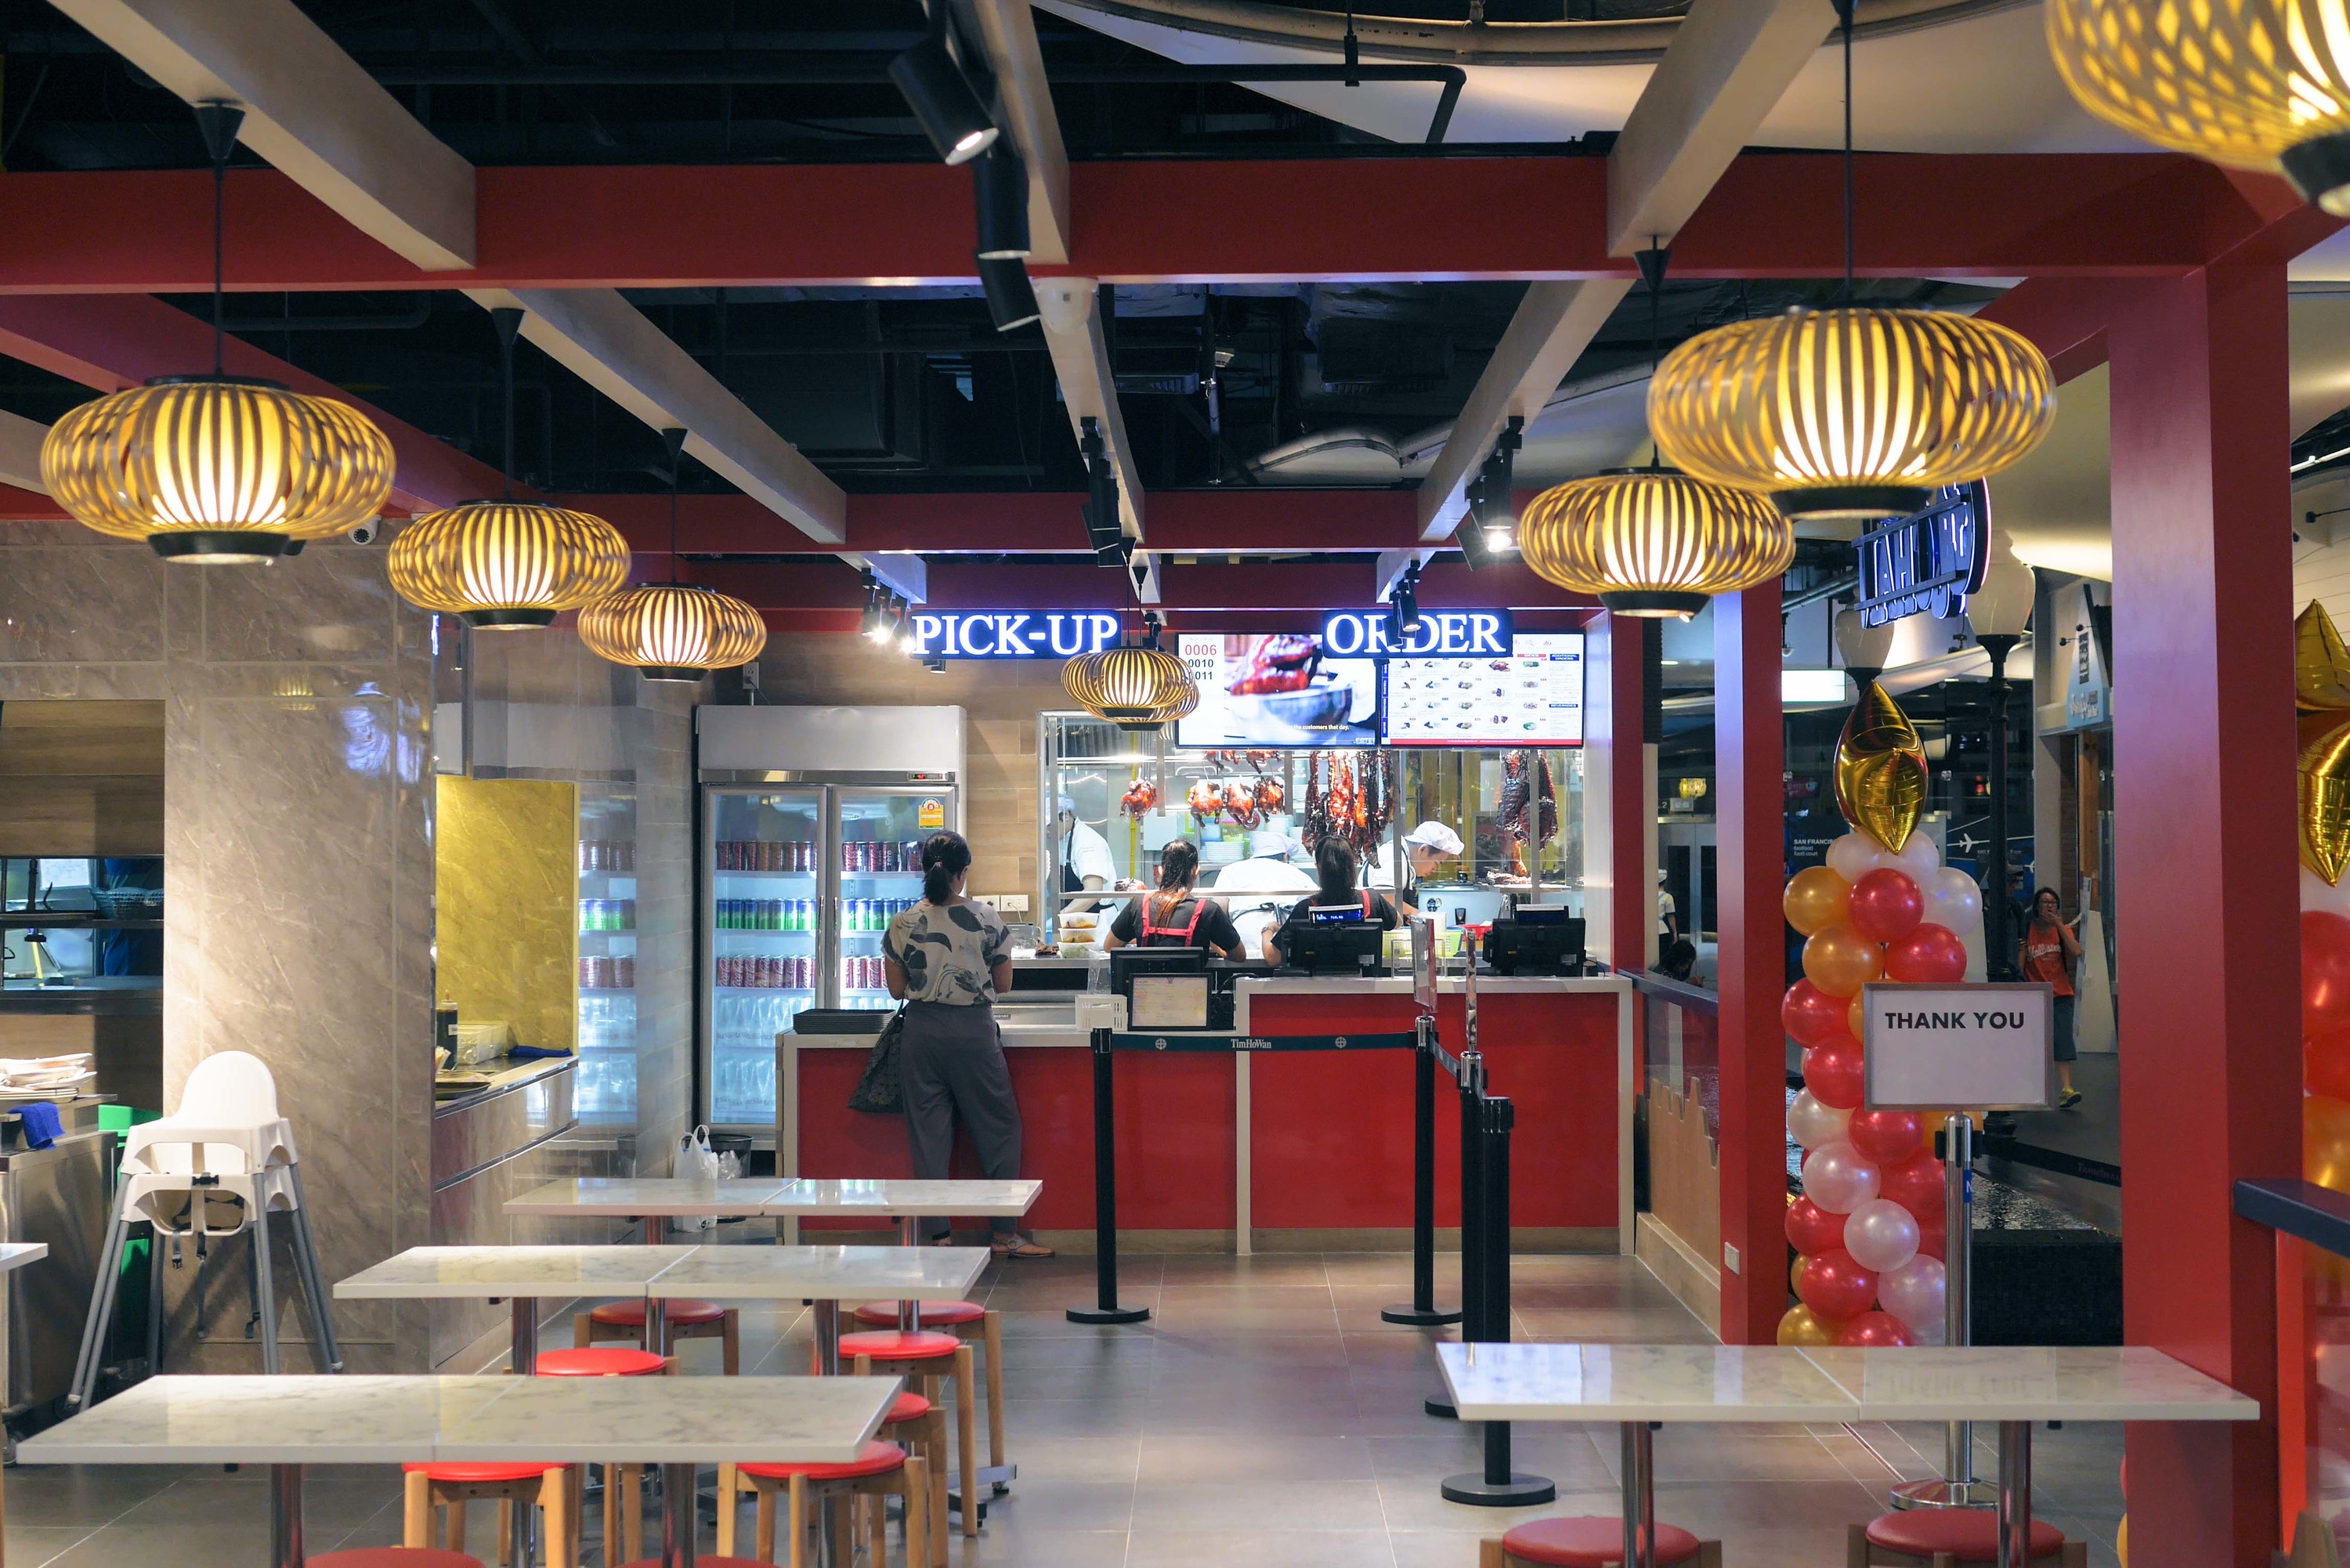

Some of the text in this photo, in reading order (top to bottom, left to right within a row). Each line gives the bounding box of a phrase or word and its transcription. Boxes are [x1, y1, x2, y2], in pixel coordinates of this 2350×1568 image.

[911, 615, 1118, 656] PICK-UP
[1326, 614, 1506, 654] ORDER
[1184, 644, 1217, 656] 0006
[1188, 659, 1213, 668] 0010
[1191, 671, 1213, 680] 011
[1885, 1012, 2025, 1029] THANK YOU
